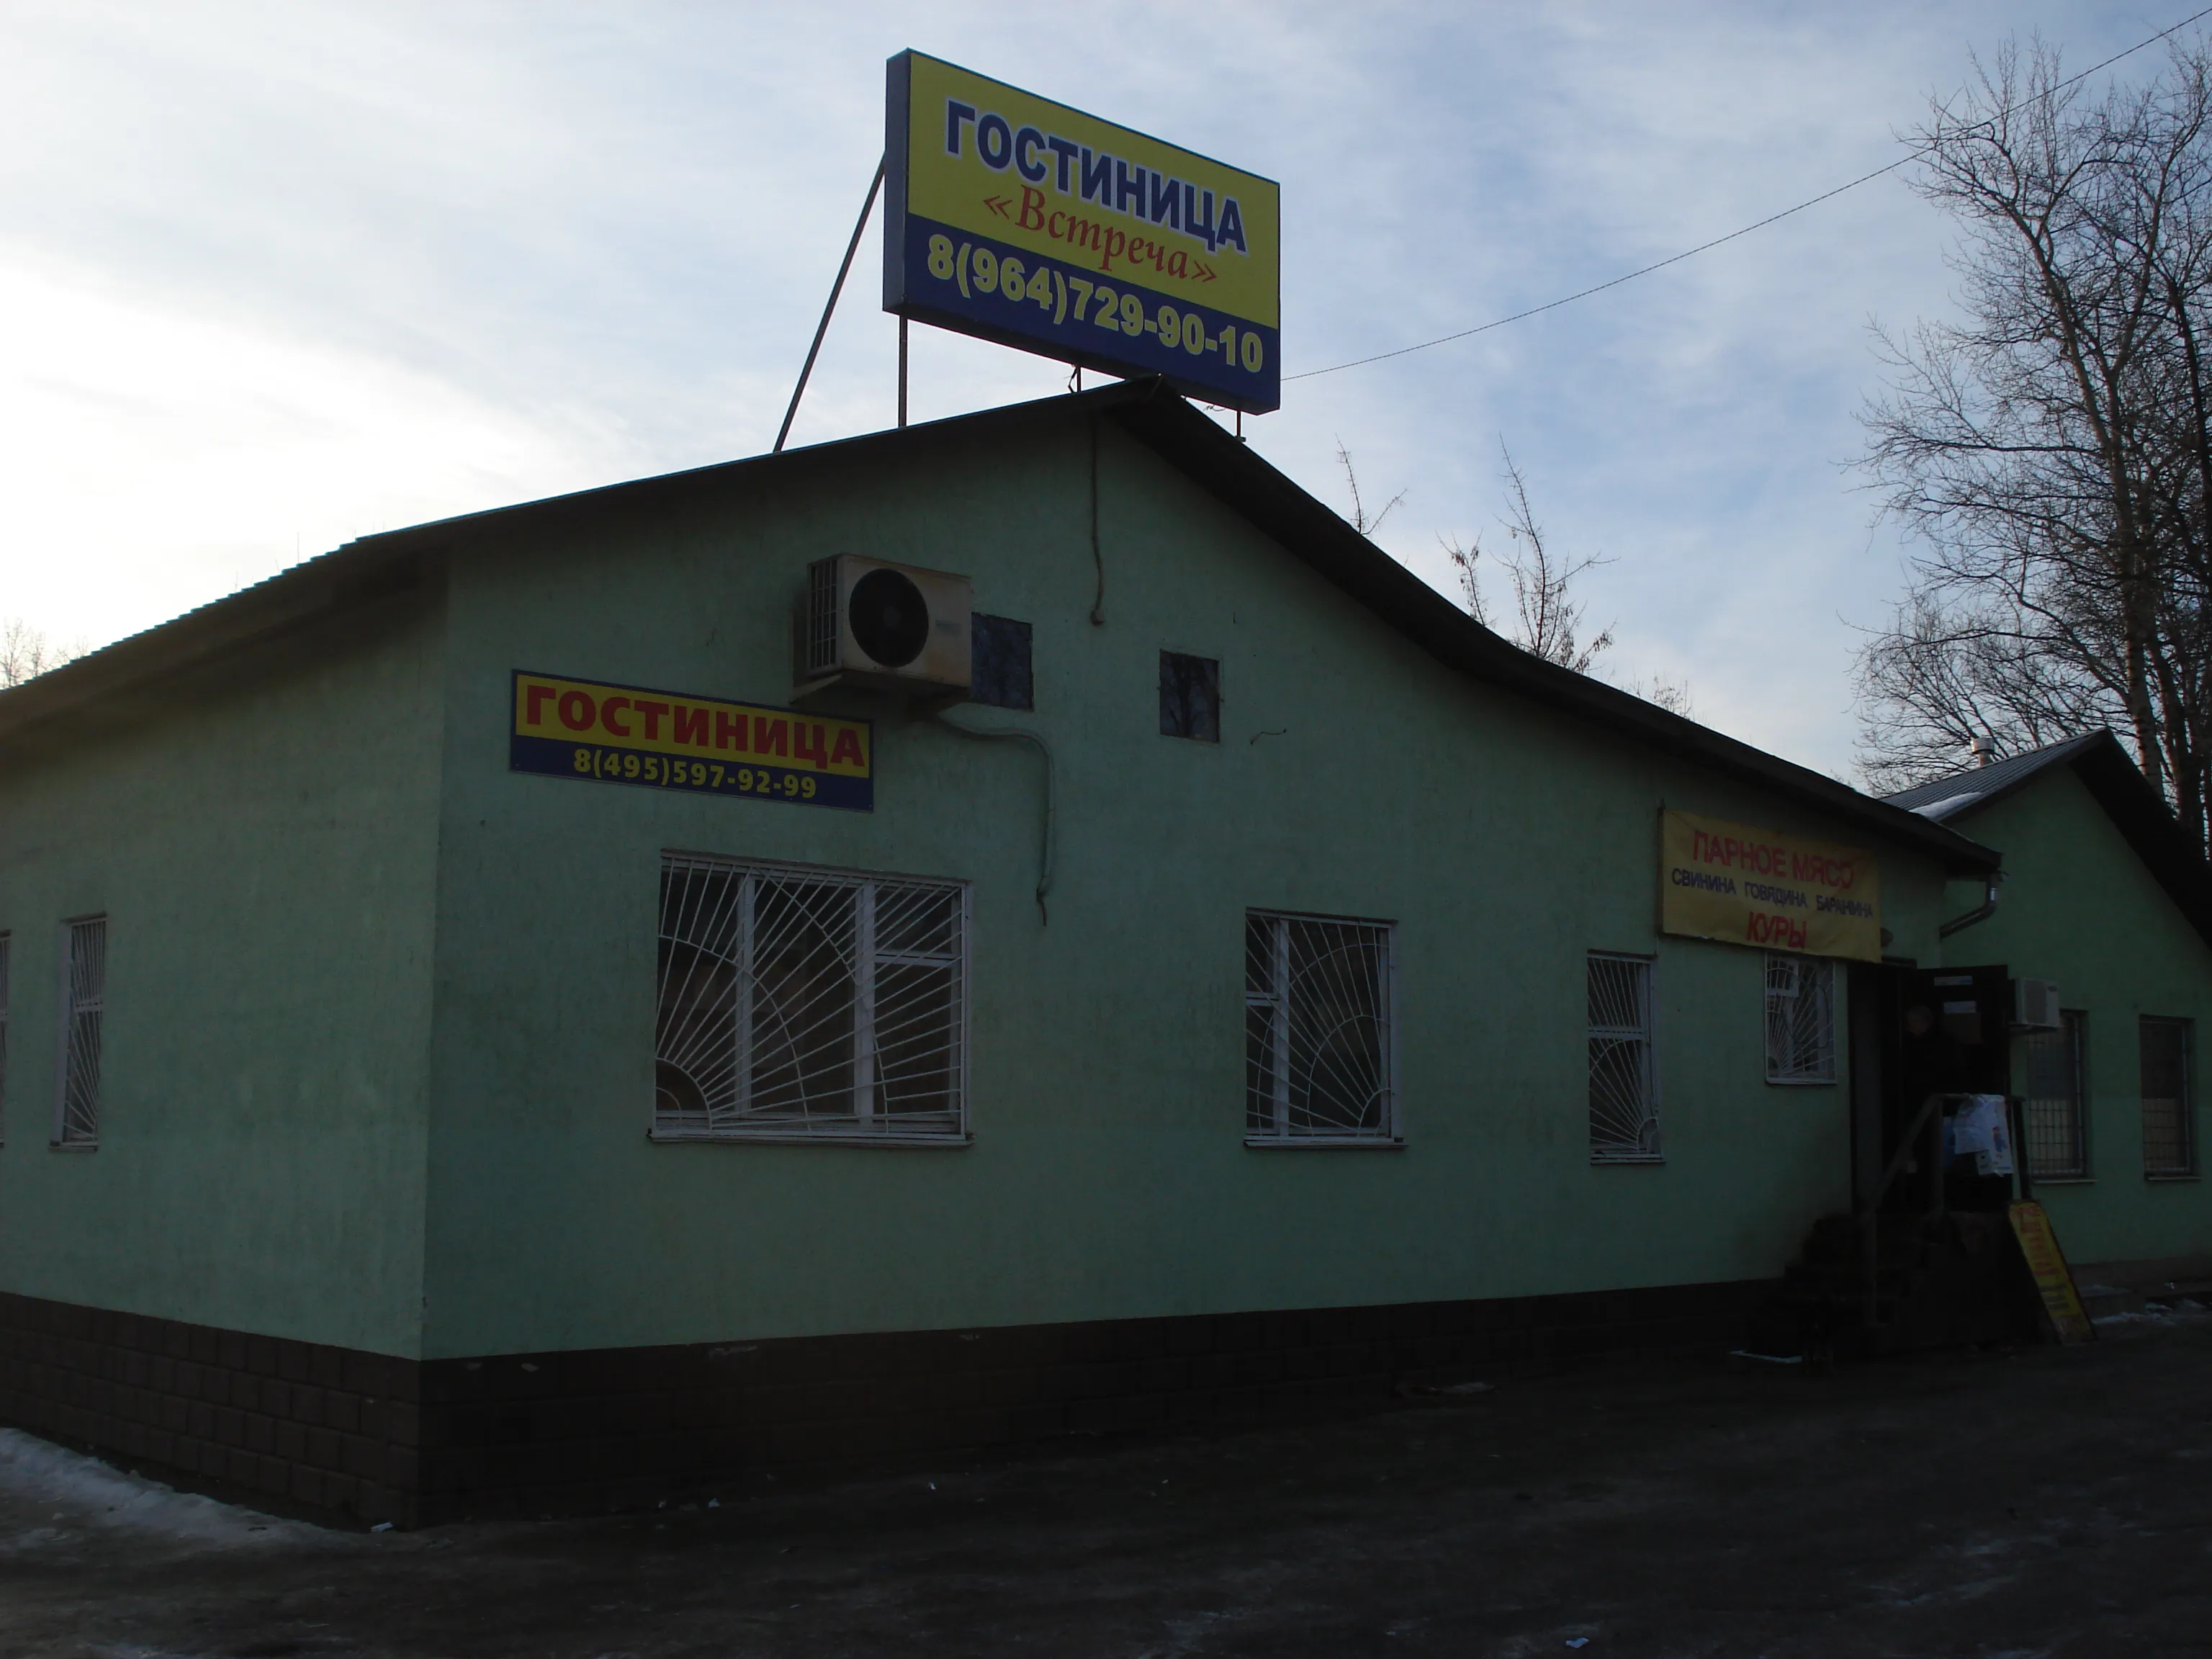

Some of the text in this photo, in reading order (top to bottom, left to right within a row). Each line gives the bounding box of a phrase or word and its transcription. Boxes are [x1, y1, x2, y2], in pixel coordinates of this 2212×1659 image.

[945, 99, 1248, 254] ГОСТИНИЦА
[984, 184, 1217, 283] «Встреча»
[927, 234, 1263, 373] 8(964)729-90-10
[526, 684, 866, 769] ГОСТИНИЦА
[574, 749, 817, 799] 8(495)597-92-99
[1672, 868, 1873, 919] СВИНИНА ГОВЯДИНА БАРАНИНА
[1693, 830, 1855, 889] ПАРНОЕ МЯСО
[1747, 911, 1807, 949] КУРЫ
